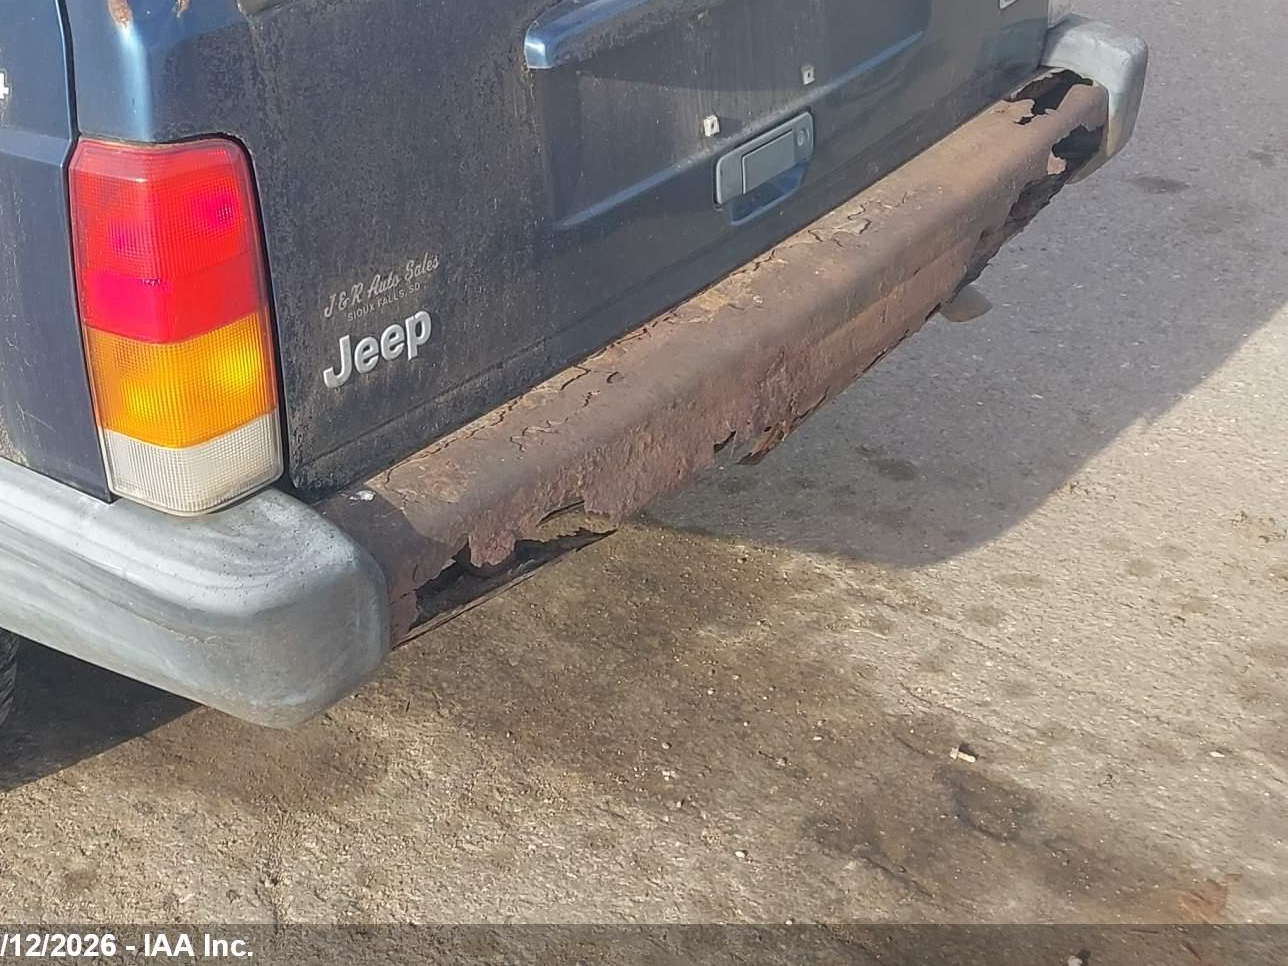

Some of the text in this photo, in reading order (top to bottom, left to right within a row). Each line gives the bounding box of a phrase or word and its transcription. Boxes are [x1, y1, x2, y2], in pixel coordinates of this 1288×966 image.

[368, 271, 400, 298] Auto
[404, 251, 440, 281] Sales
[348, 303, 375, 322] SIOUX
[322, 310, 432, 388] Jeep
